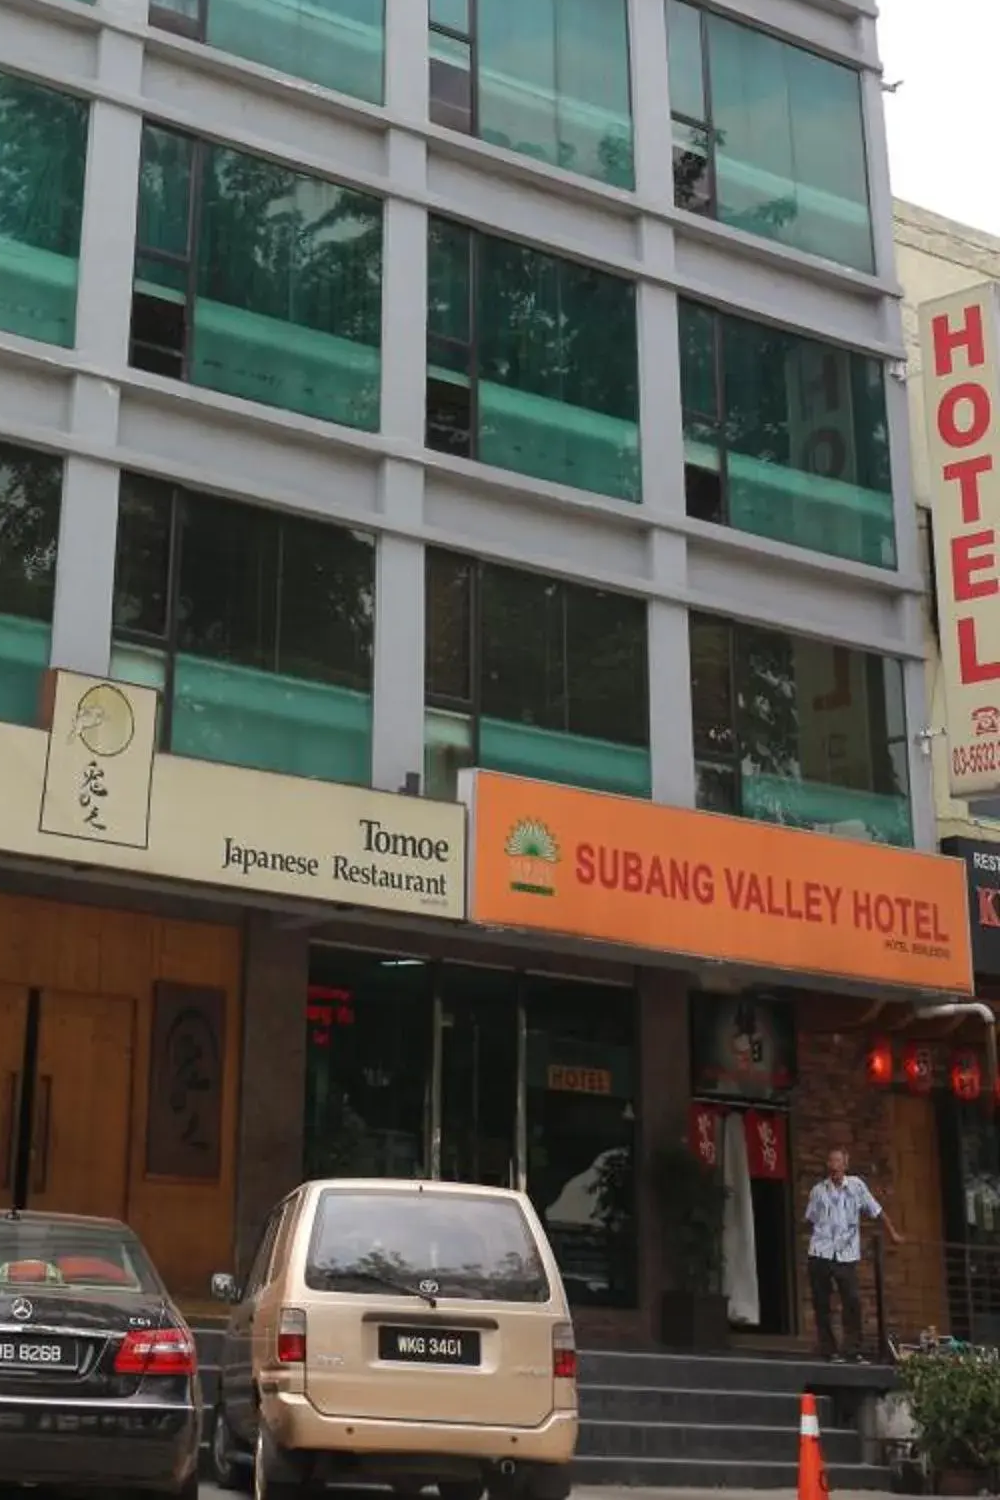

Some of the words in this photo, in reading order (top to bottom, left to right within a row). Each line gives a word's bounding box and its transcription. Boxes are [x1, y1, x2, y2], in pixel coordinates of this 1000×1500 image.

[932, 304, 1000, 685] HOTEL
[222, 837, 319, 876] Japanese
[332, 855, 448, 896] Restaurant
[359, 819, 449, 863] Tomoe
[575, 842, 715, 905] SUBANG
[723, 867, 843, 926] VALLEY
[853, 890, 949, 943] HOTEL
[549, 1067, 612, 1093] HOTEL
[398, 1335, 425, 1354] WKG
[428, 1337, 461, 1357] 3401
